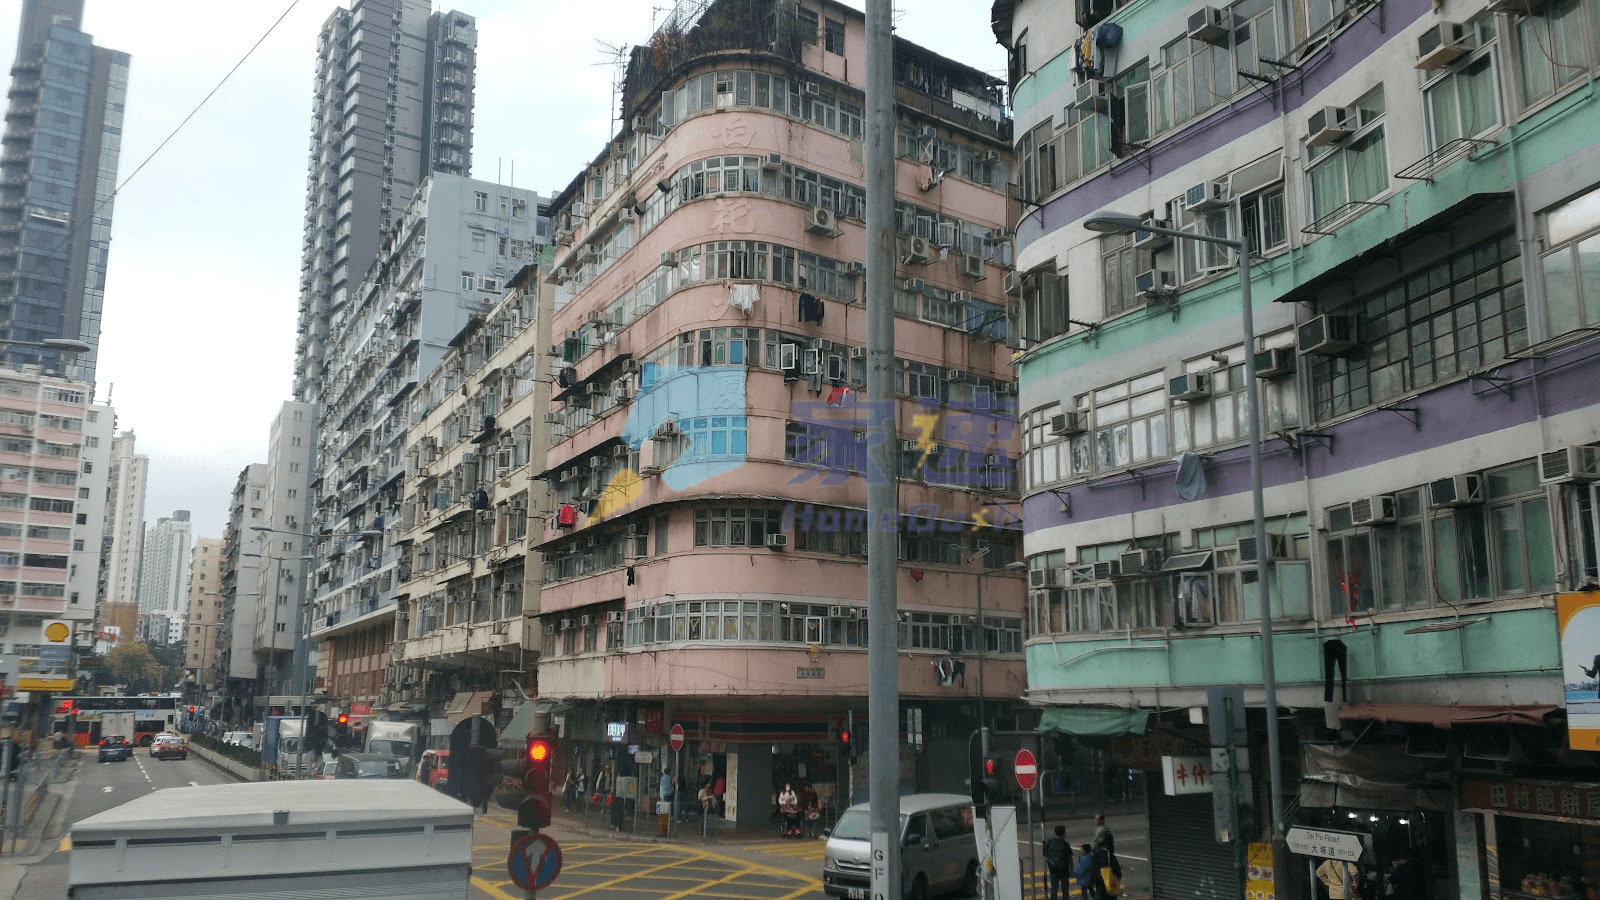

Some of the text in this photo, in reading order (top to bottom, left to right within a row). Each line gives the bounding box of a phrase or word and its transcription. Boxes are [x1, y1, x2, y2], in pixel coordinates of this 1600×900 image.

[1306, 832, 1340, 843] Tai Po Road
[1312, 844, 1335, 857] 大埔道
